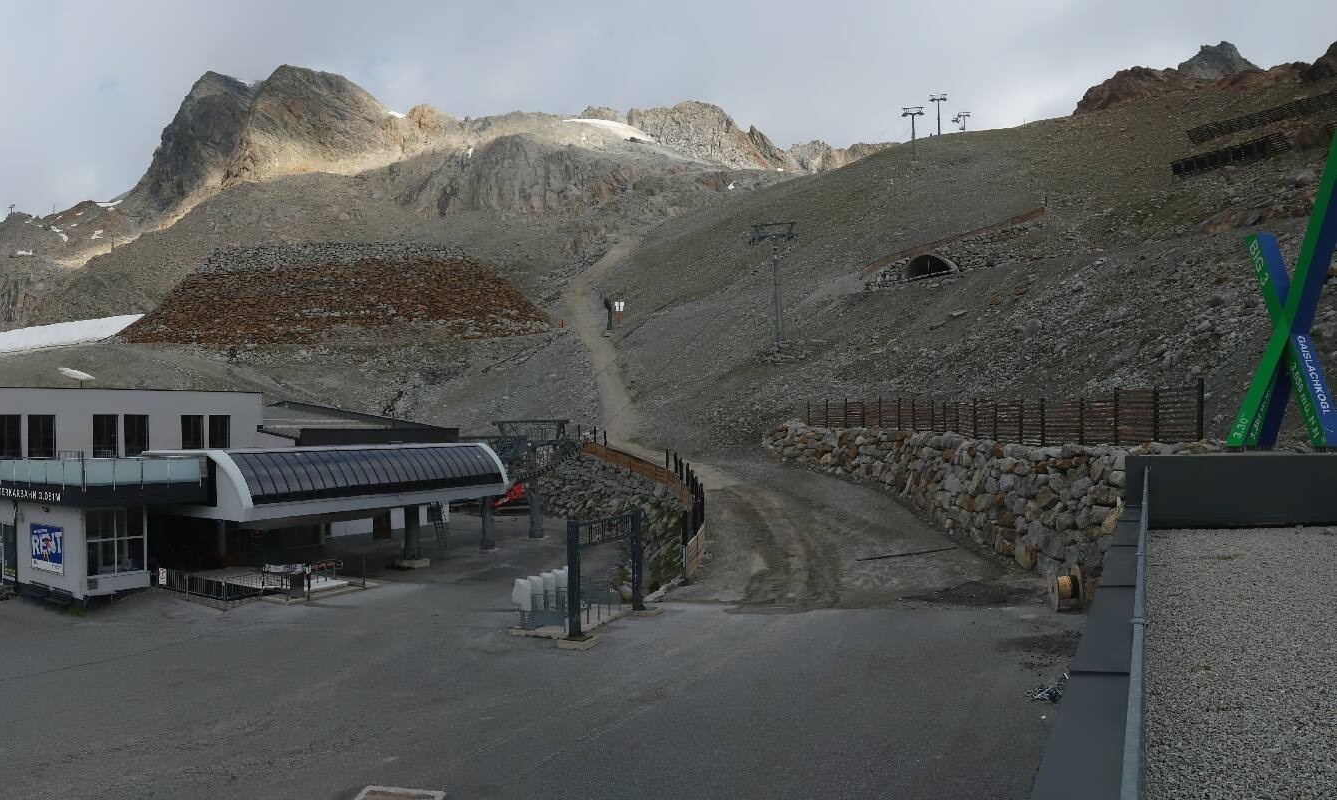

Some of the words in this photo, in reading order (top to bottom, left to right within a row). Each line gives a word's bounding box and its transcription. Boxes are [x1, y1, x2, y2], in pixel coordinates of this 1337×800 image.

[1250, 239, 1264, 272] BIG
[1260, 272, 1269, 286] 3
[1297, 335, 1331, 415] GAISLACHKOGL
